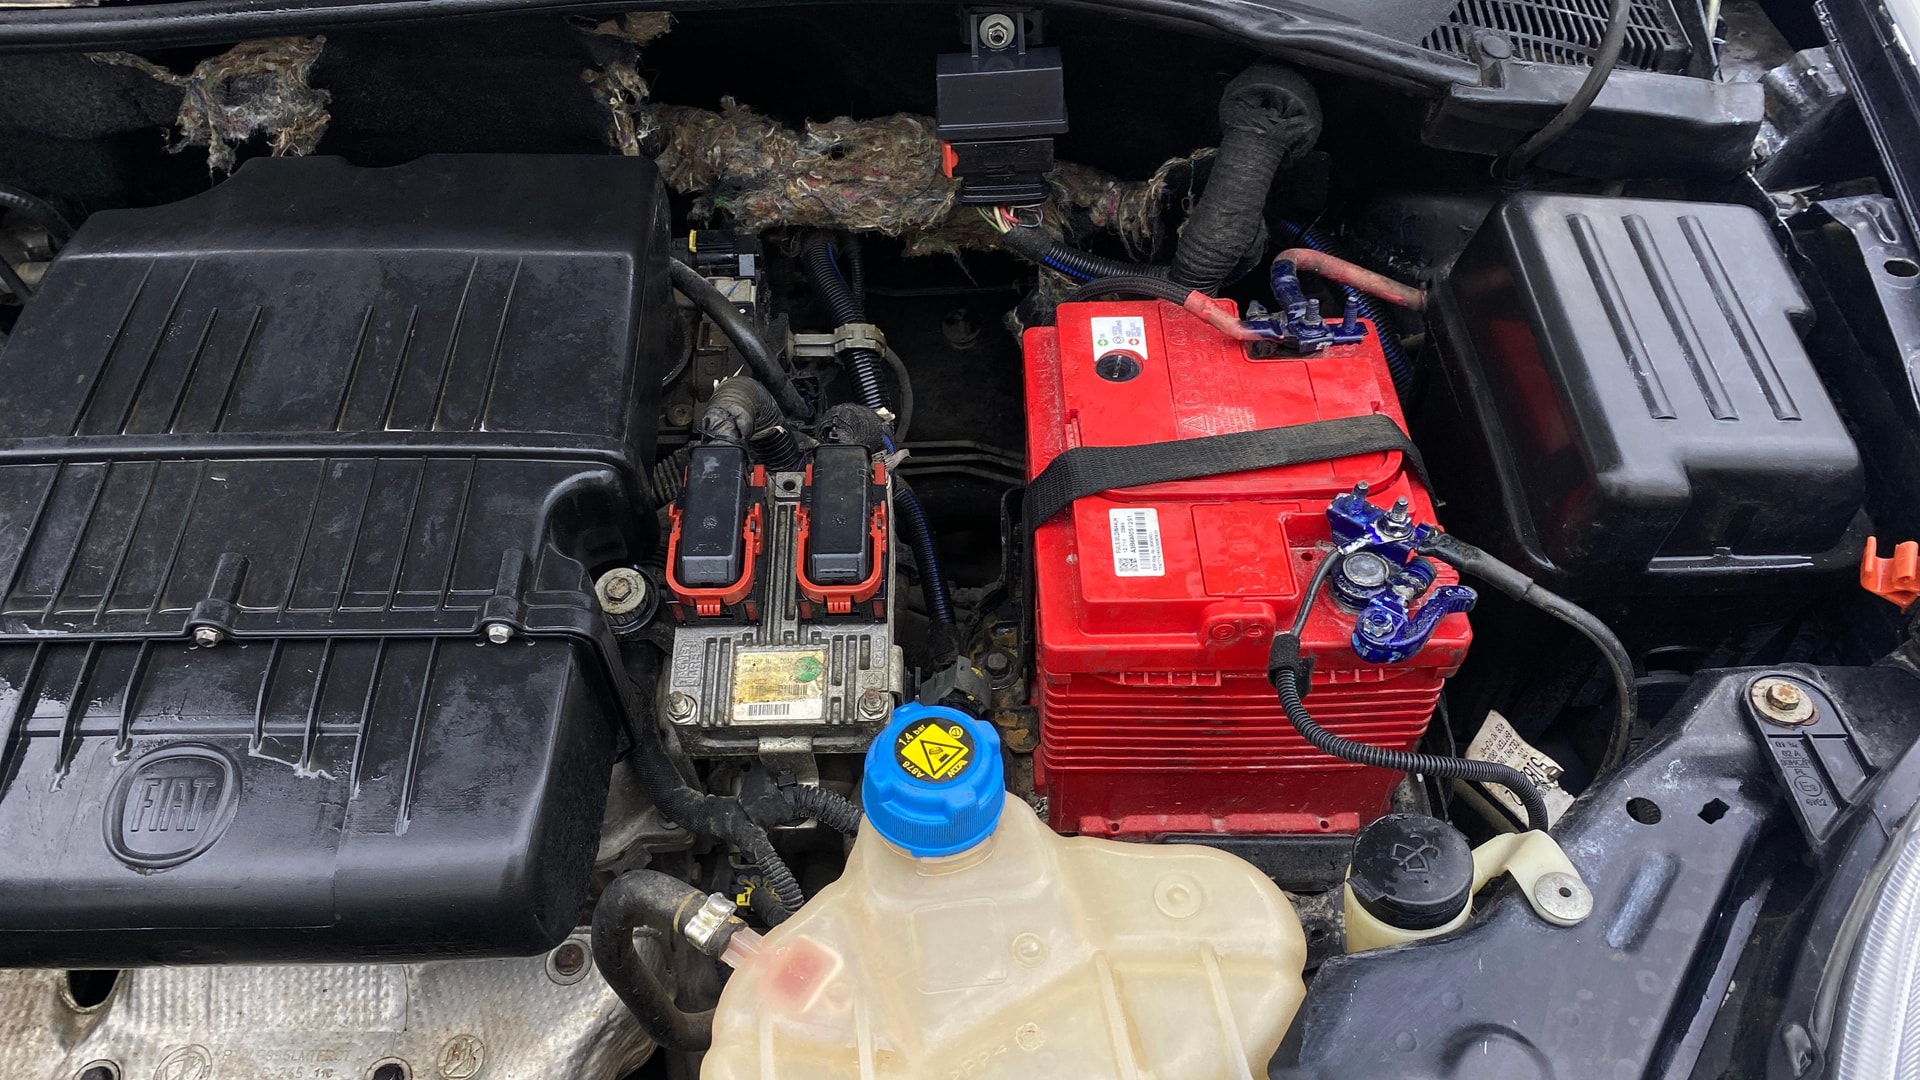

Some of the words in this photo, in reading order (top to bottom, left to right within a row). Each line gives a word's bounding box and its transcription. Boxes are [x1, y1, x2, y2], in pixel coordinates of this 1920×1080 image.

[898, 732, 914, 746] 1.4
[912, 724, 926, 736] bar
[902, 761, 925, 778] A878
[130, 777, 217, 833] FIAT
